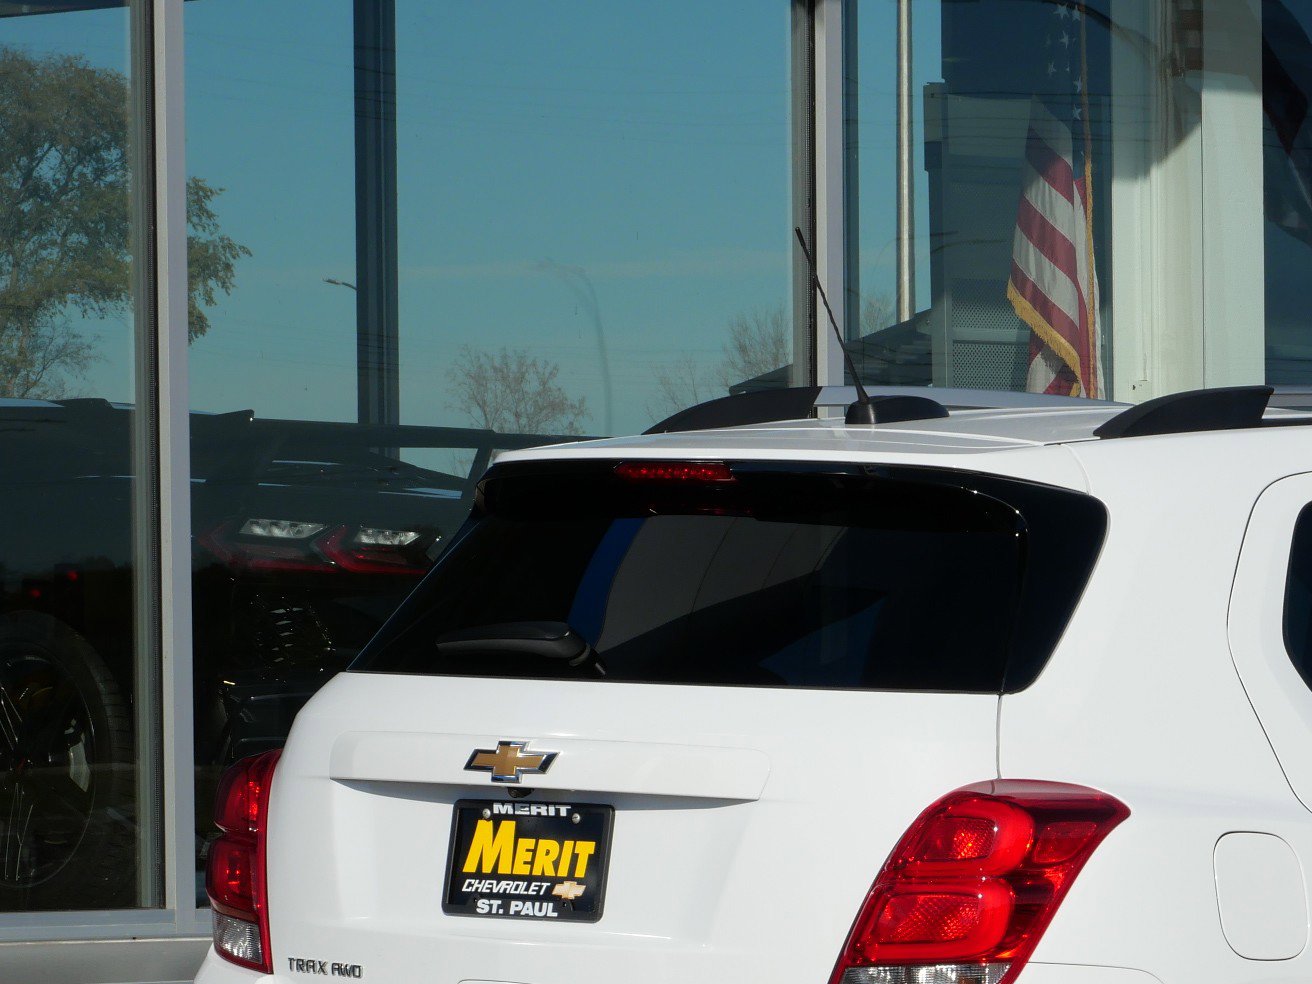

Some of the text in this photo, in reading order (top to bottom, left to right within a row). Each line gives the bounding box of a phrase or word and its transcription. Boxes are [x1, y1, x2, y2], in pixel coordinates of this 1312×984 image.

[493, 802, 572, 817] MERIT
[462, 819, 596, 878] MERIT
[462, 879, 551, 895] CHEVROLET
[476, 899, 558, 917] ST. PAUL
[288, 957, 363, 979] TRAX AWD
